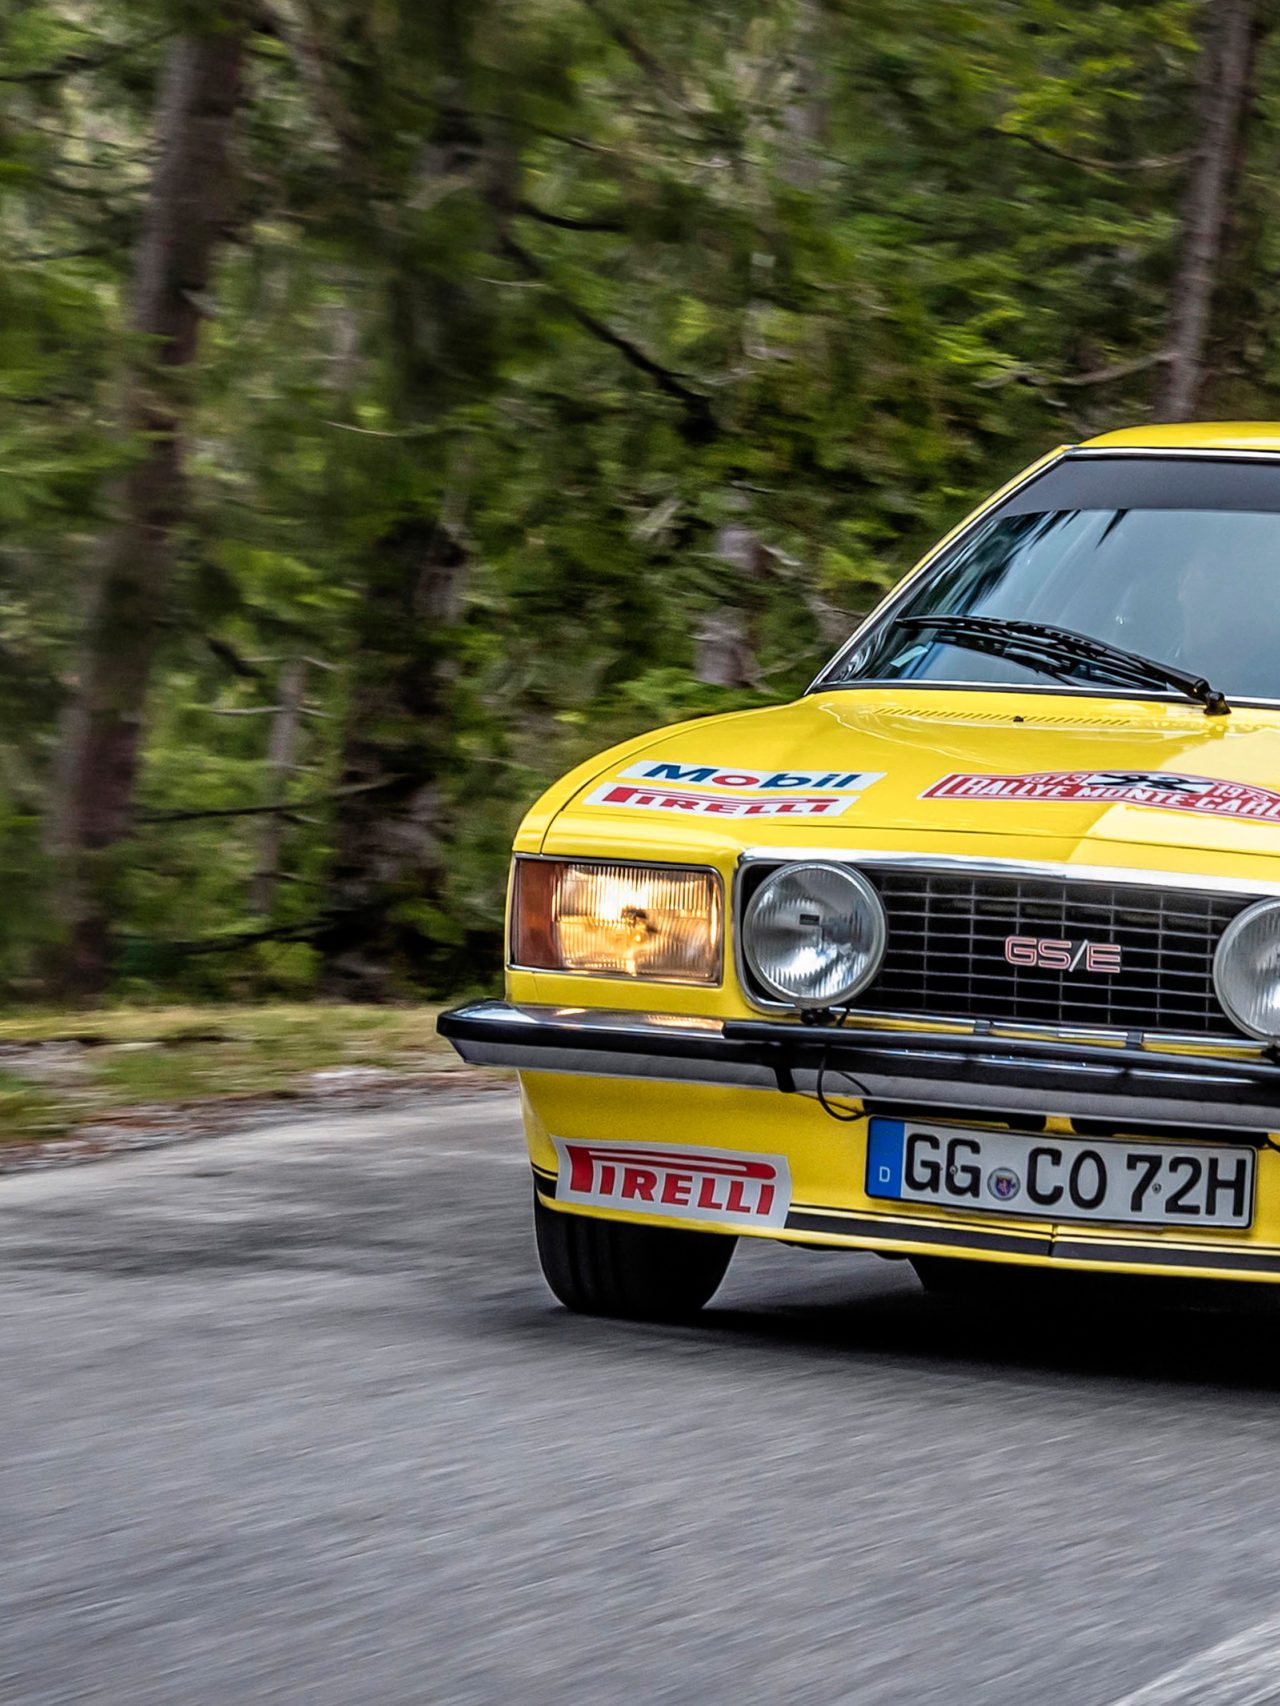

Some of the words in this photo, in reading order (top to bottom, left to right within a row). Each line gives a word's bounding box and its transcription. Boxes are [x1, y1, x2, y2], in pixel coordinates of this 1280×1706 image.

[642, 763, 863, 789] Mobil
[955, 777, 1072, 797] RALLYE
[602, 786, 839, 814] PIRELLI
[1005, 935, 1121, 973] GS/E
[565, 1144, 776, 1216] PIRELLI
[879, 1167, 890, 1183] D
[905, 1133, 981, 1198] GG
[1026, 1146, 1108, 1210] CO
[1126, 1153, 1247, 1217] 72H
